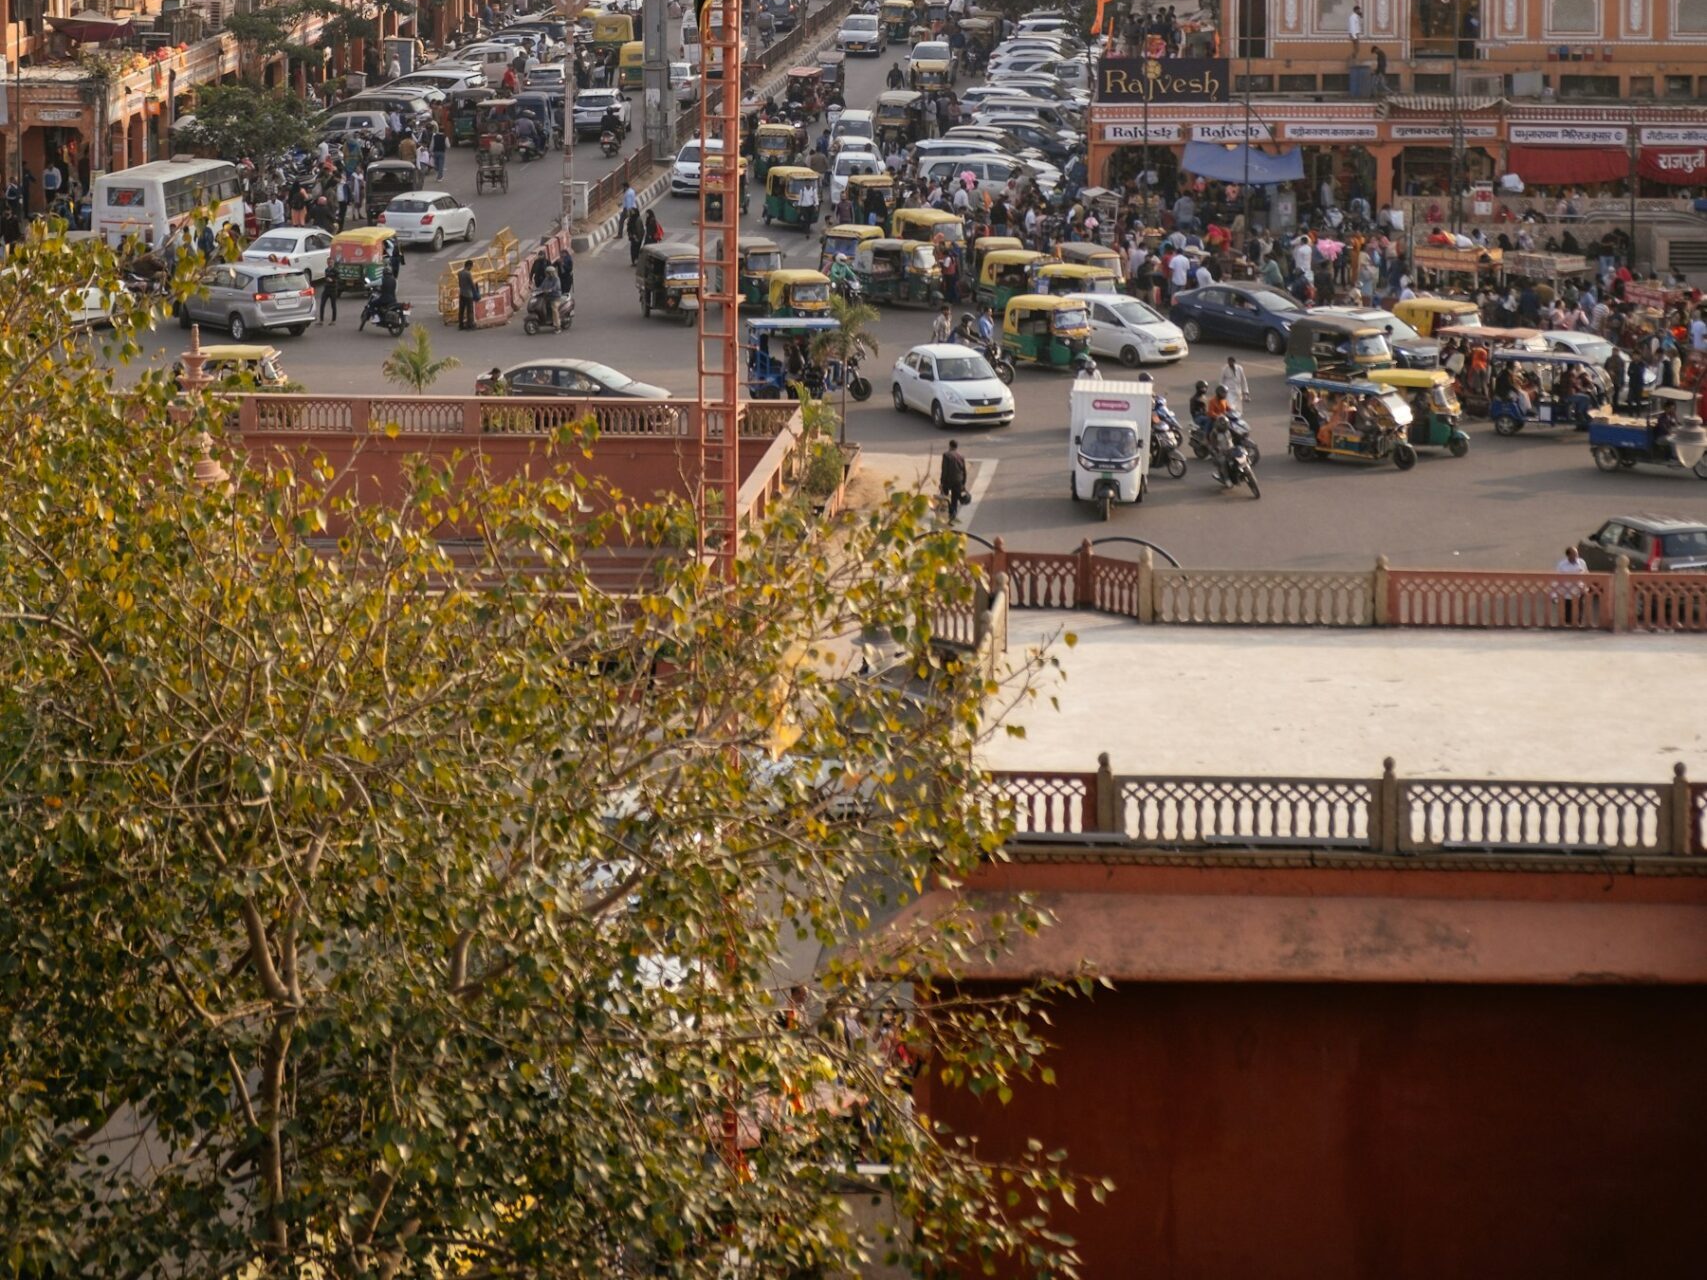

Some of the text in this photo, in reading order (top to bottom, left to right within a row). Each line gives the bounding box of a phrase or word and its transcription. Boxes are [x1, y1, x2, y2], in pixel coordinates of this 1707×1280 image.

[1104, 66, 1219, 102] Rajvesh
[1112, 126, 1172, 139] Rajvesh
[1201, 126, 1259, 138] Rajvesh
